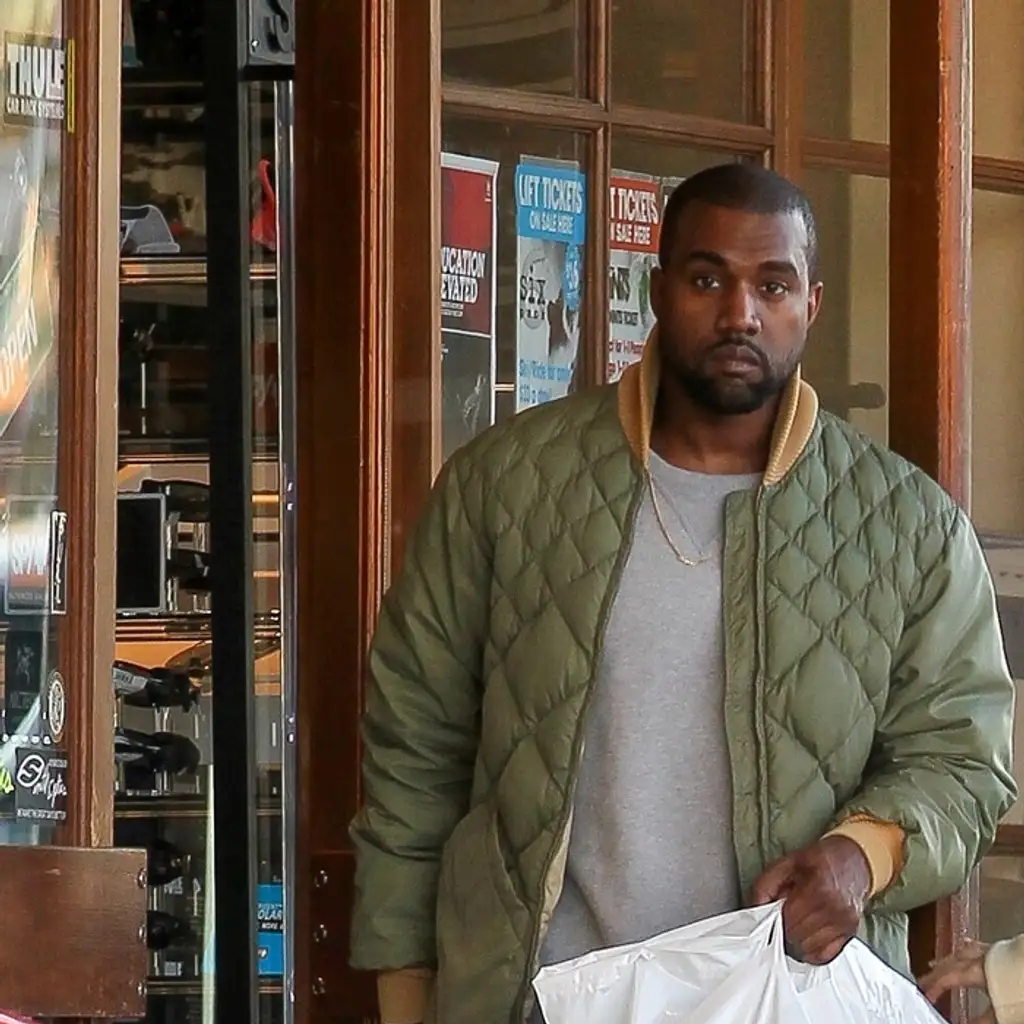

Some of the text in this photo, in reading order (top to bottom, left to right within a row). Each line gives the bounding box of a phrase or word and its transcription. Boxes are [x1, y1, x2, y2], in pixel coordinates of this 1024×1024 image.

[7, 42, 65, 100] THULE
[520, 174, 583, 213] LIFT TICKETS
[617, 188, 659, 224] TICKETS
[529, 209, 573, 234] ON SALE HERE
[616, 222, 632, 242] SALE
[633, 224, 650, 245] HERE
